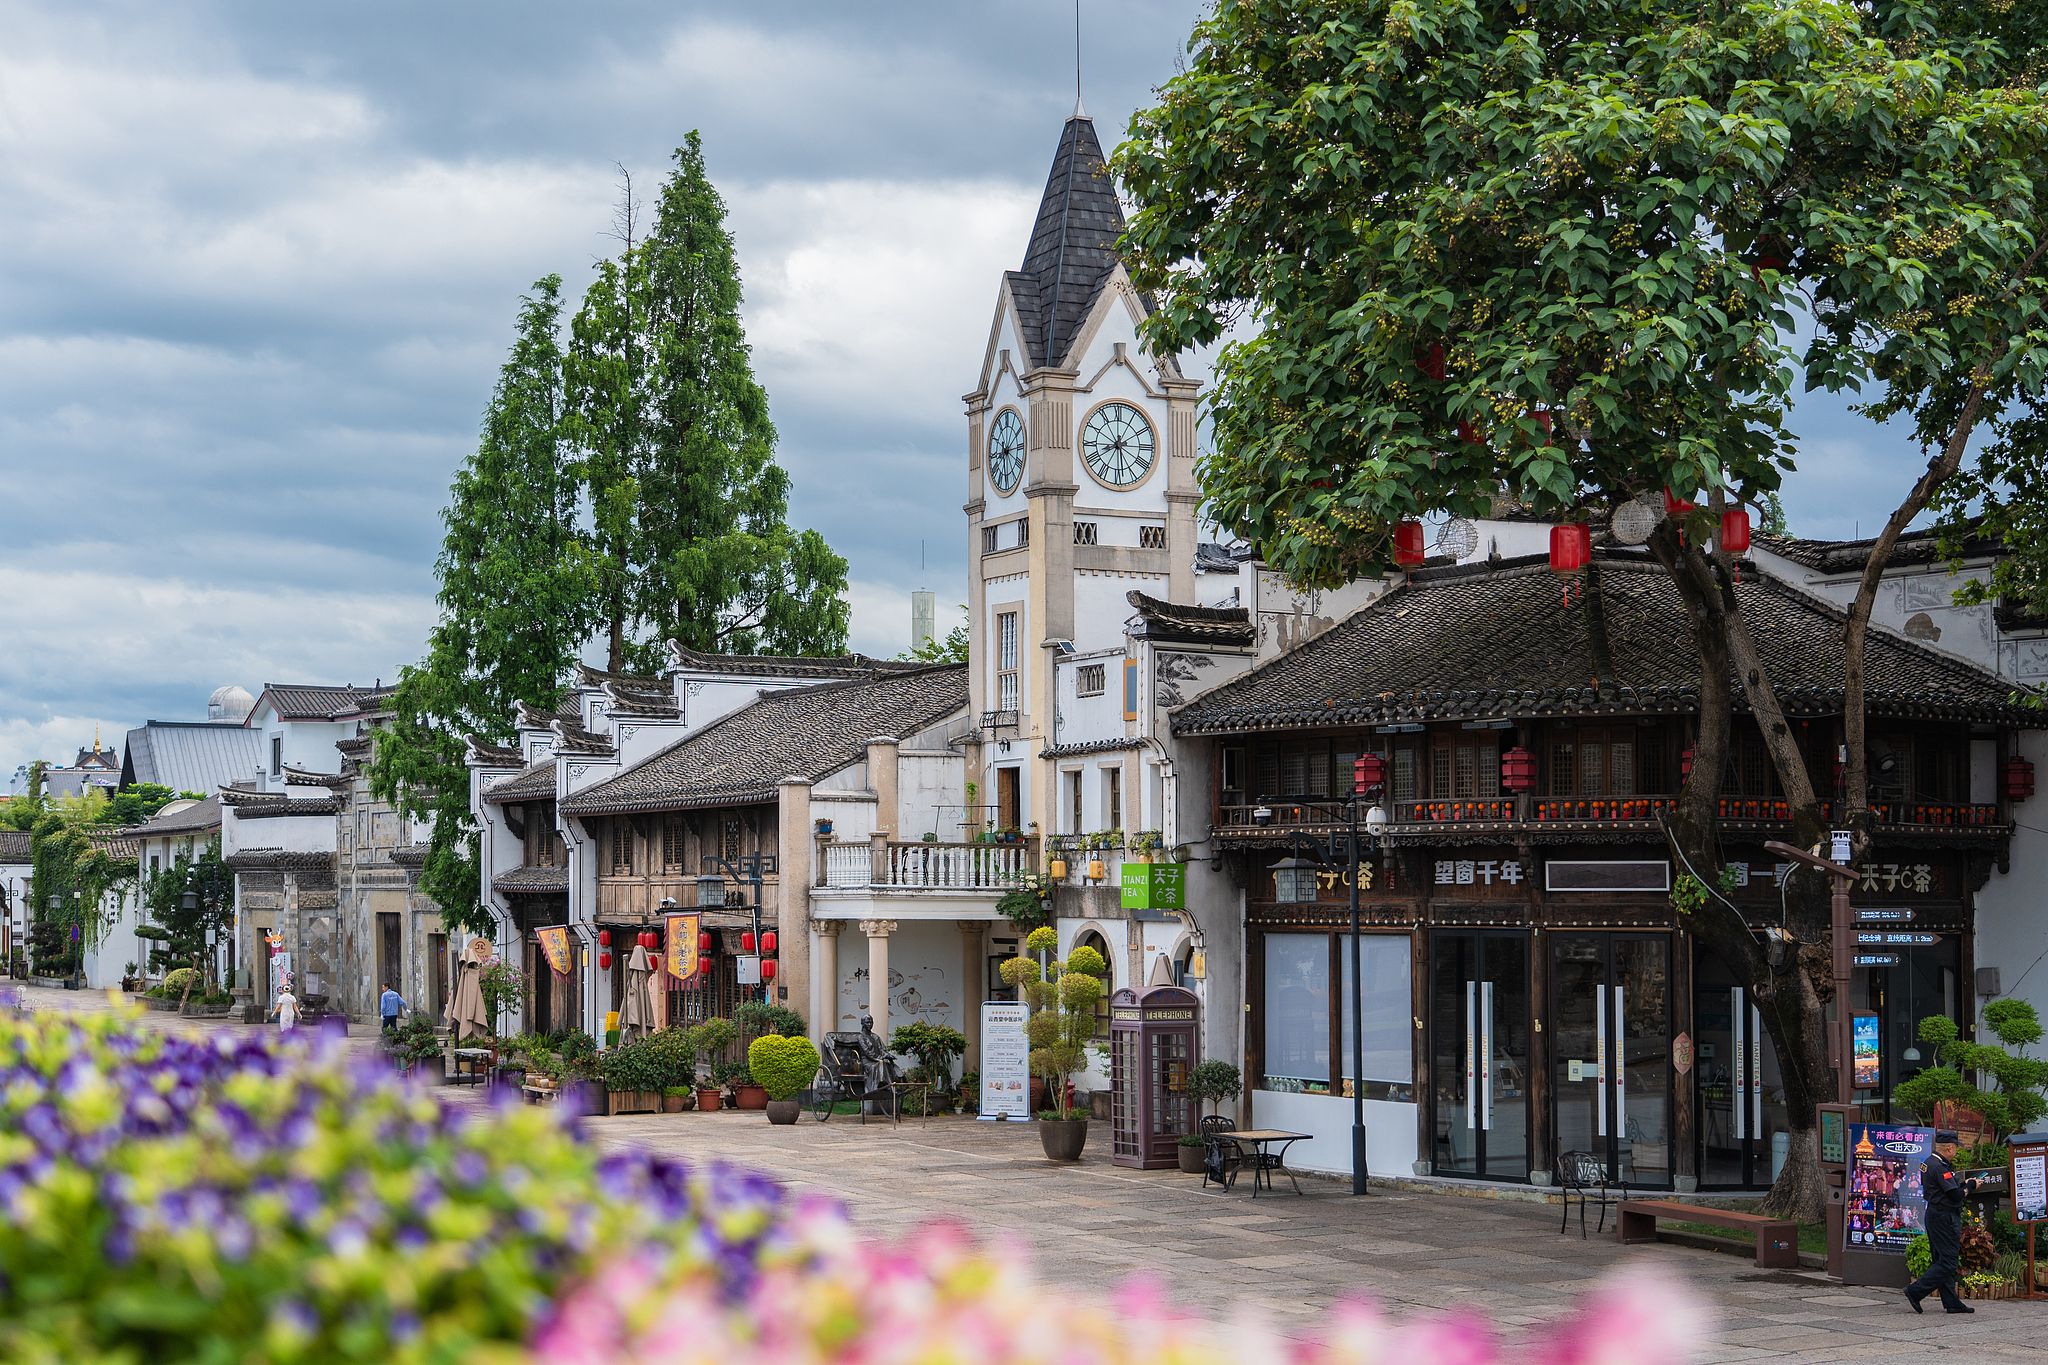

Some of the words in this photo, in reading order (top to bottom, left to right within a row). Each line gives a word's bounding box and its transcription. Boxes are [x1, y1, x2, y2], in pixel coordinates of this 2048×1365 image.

[1154, 868, 1179, 884] 天子
[1434, 860, 1524, 885] 望窗千年
[1122, 875, 1148, 885] TIANZI
[1123, 888, 1138, 897] TEA
[1886, 934, 1912, 943] 直线距离
[1115, 1010, 1140, 1020] TELEPHONE
[1146, 1010, 1192, 1020] TELEPHONE
